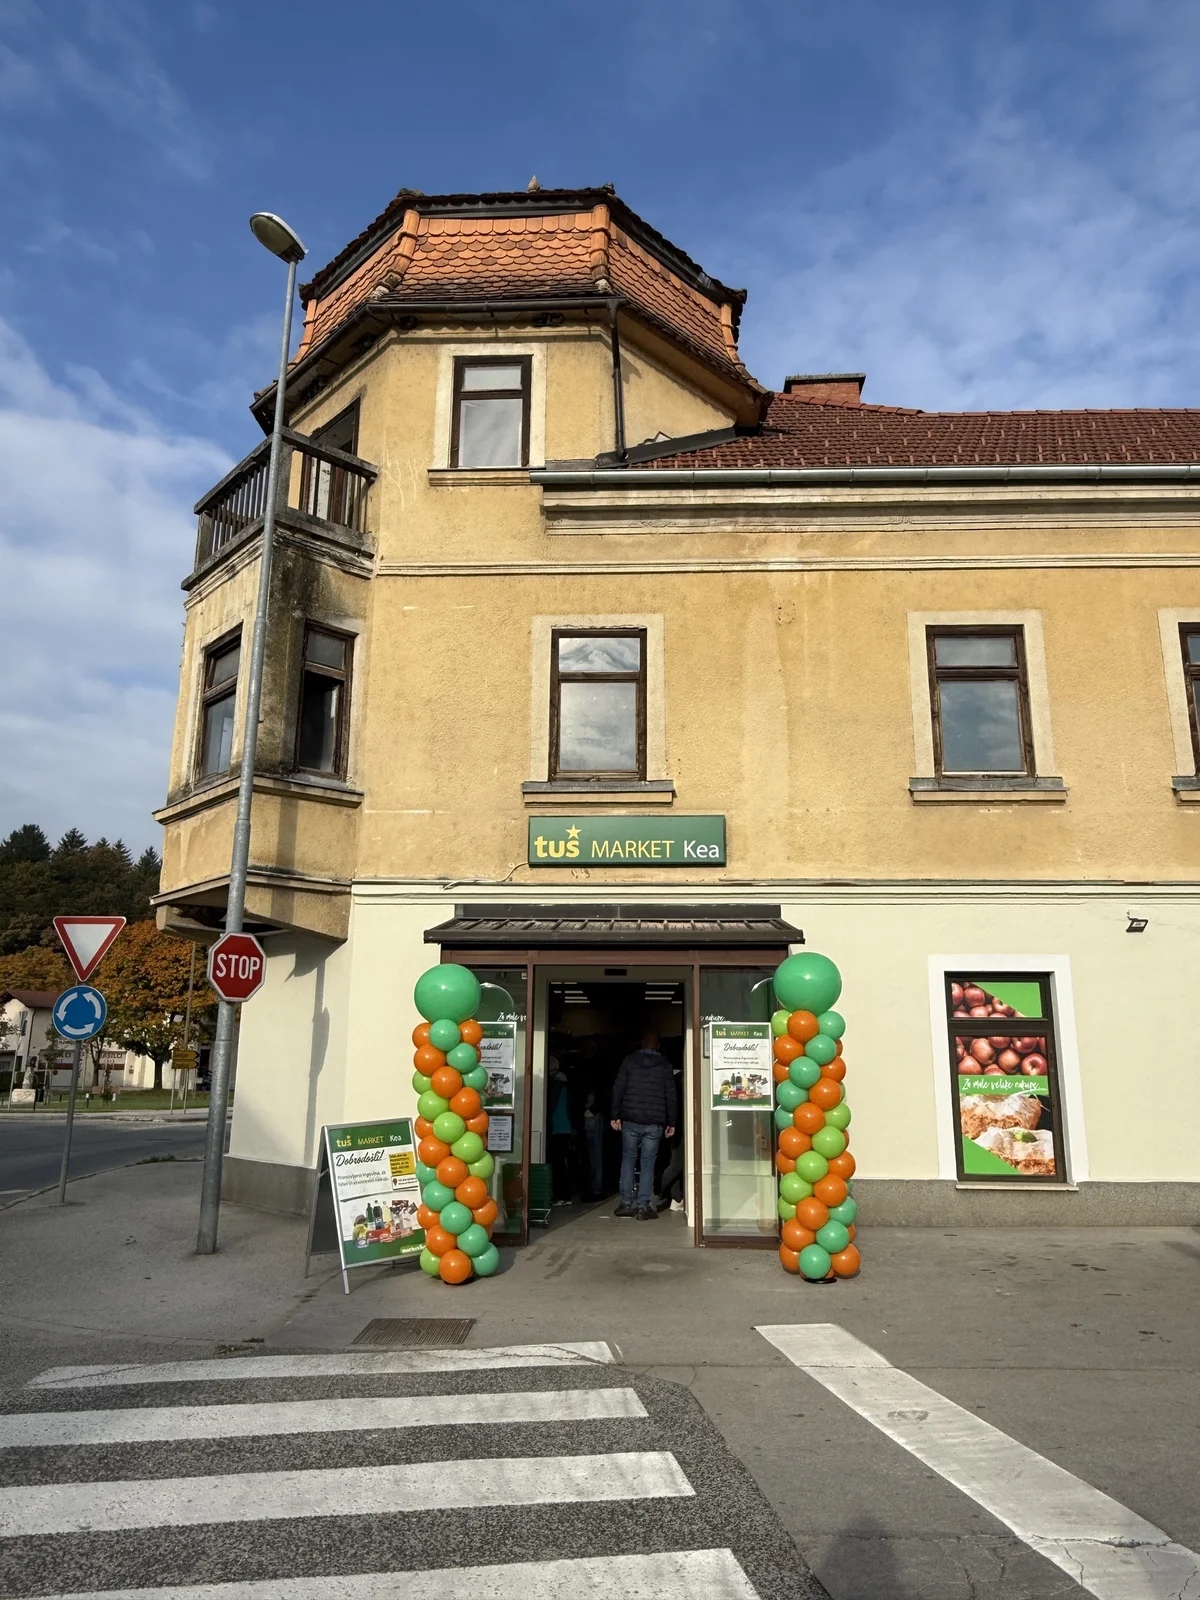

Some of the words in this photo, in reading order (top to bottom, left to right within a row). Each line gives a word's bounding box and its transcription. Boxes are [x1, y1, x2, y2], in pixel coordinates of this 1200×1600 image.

[591, 840, 675, 858] MARKET
[683, 840, 720, 858] Kea
[216, 953, 261, 980] STOP
[962, 1078, 971, 1091] Za
[972, 1078, 990, 1089] male
[990, 1078, 1014, 1091] velike
[358, 1135, 384, 1145] MARKET
[390, 1134, 402, 1142] Kea
[336, 1150, 385, 1167] Dobrodošli!
